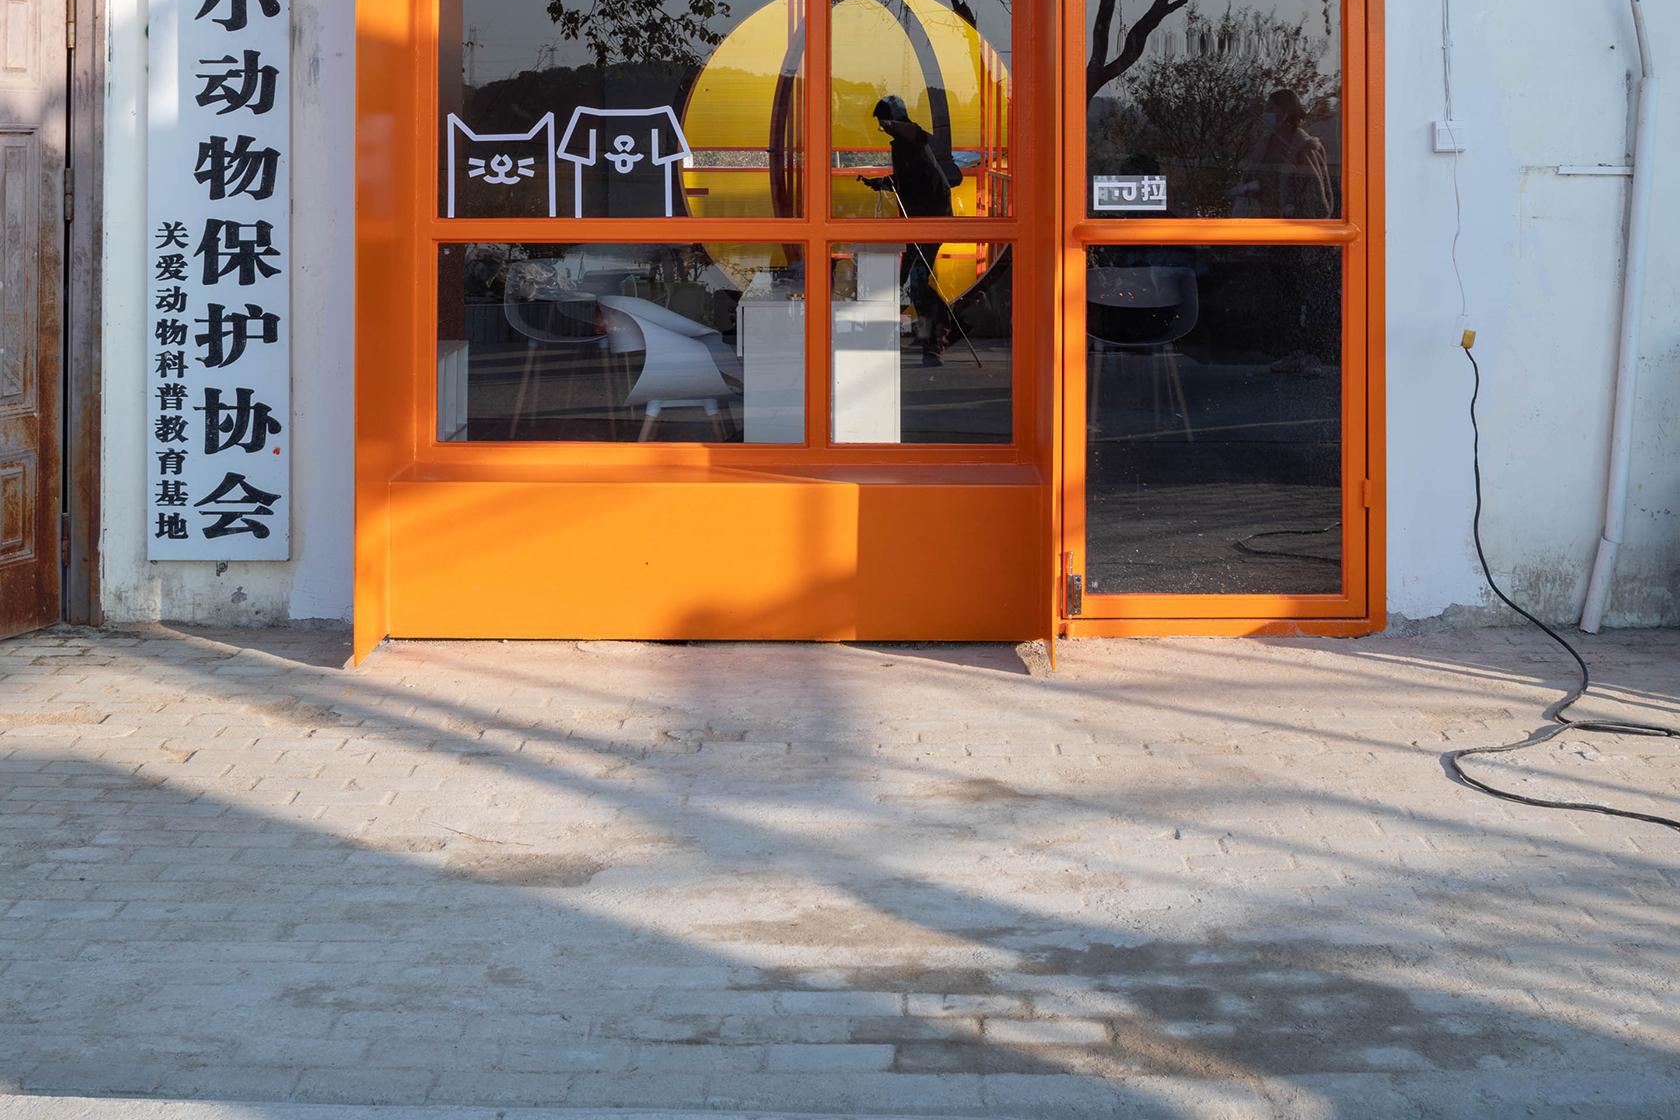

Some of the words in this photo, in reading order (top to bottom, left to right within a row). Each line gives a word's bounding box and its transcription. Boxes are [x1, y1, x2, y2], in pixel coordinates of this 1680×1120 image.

[1141, 175, 1166, 201] 拉
[155, 221, 189, 540] 关爱动物科普教育基地
